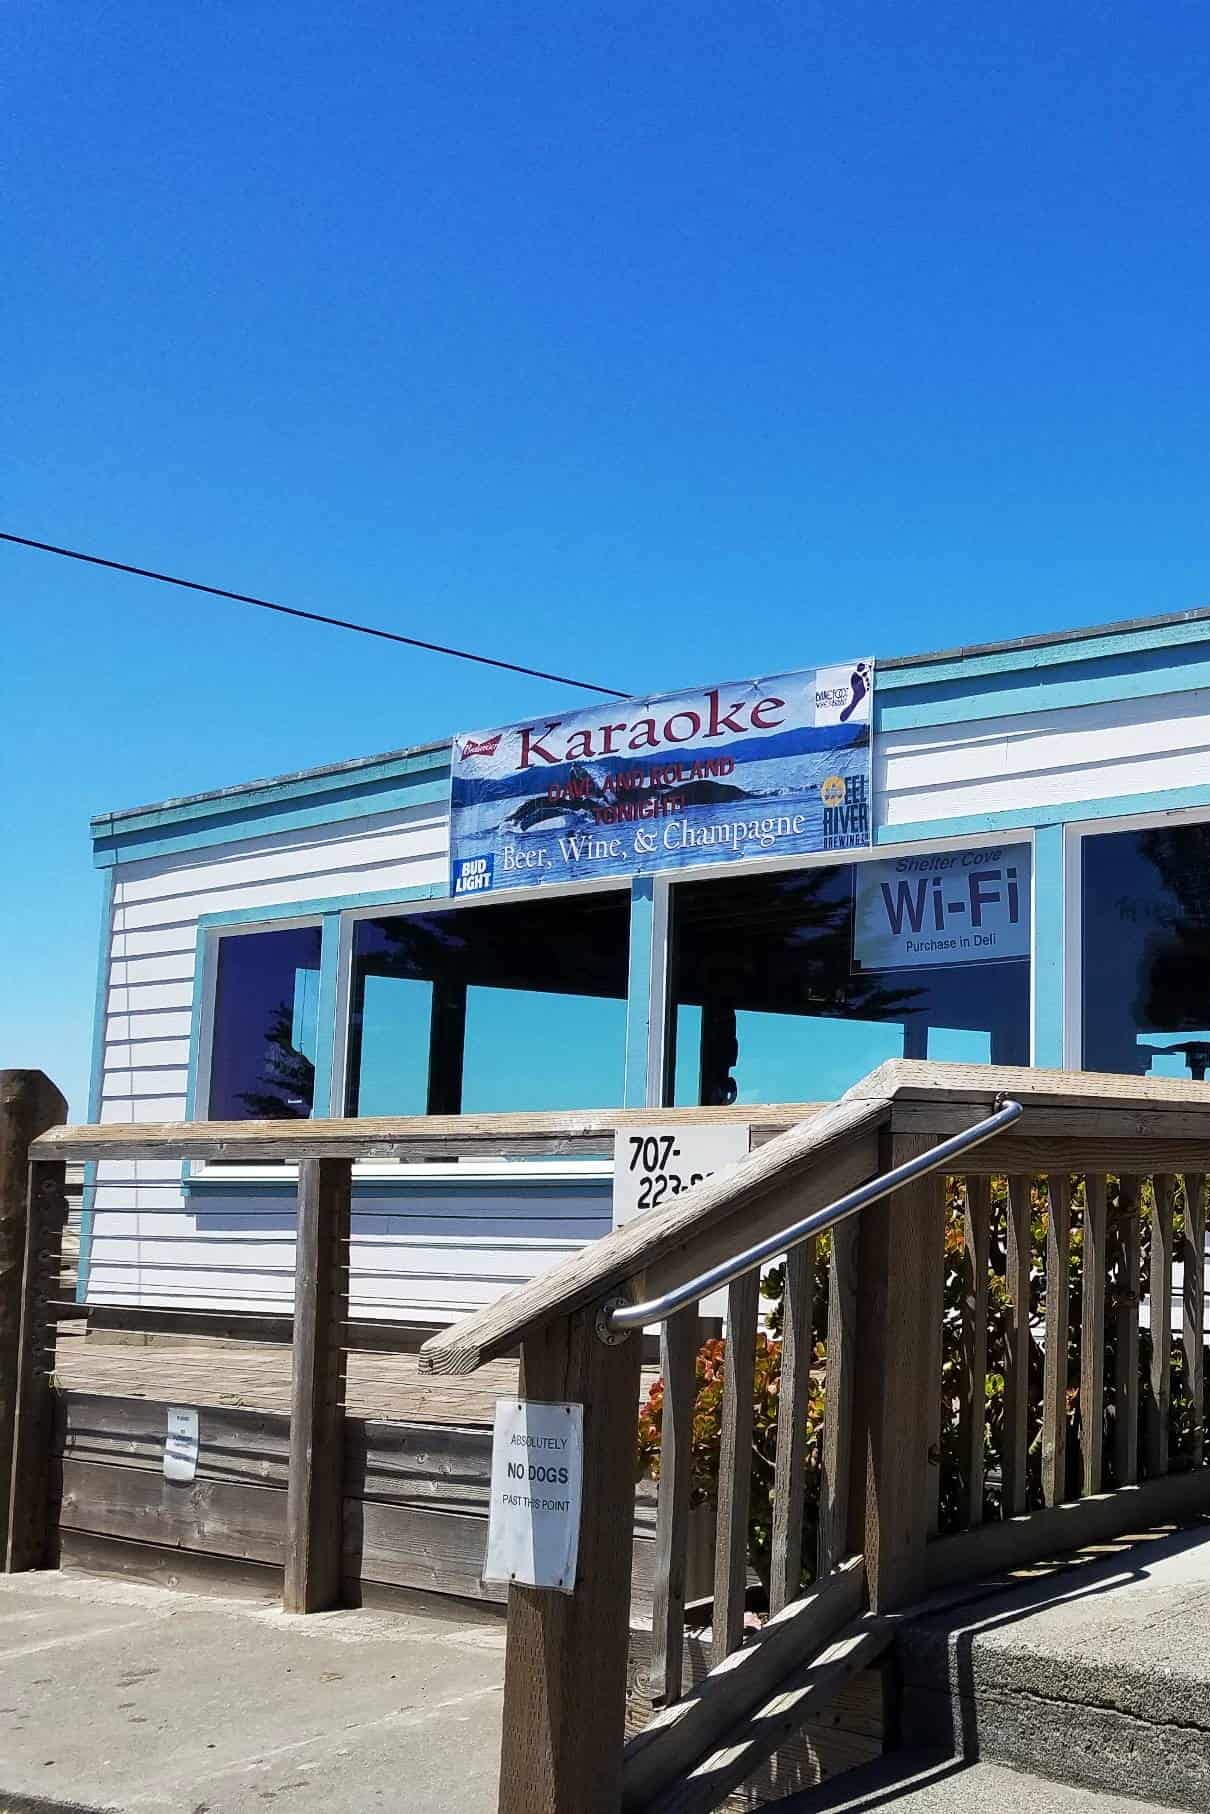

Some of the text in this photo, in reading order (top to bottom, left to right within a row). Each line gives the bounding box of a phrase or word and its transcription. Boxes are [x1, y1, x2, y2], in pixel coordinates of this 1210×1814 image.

[515, 689, 787, 770] Karaoke
[603, 769, 644, 792] AND
[649, 756, 735, 785] ROLAND
[845, 775, 866, 805] EEL
[823, 803, 868, 836] RIVER
[503, 814, 806, 872] Beer, Wine, & Champagne
[461, 859, 487, 876] BUD
[895, 850, 1002, 873] Shelter Cove
[455, 873, 492, 893] LIGHT
[880, 867, 1019, 935] Wi-Fi
[906, 933, 996, 952] Purchase in Deli
[629, 1135, 681, 1172] 707-
[510, 1433, 568, 1449] ABSOLUTELY
[508, 1462, 569, 1484] NO DOGS
[502, 1494, 571, 1513] PAST THIS POINT
